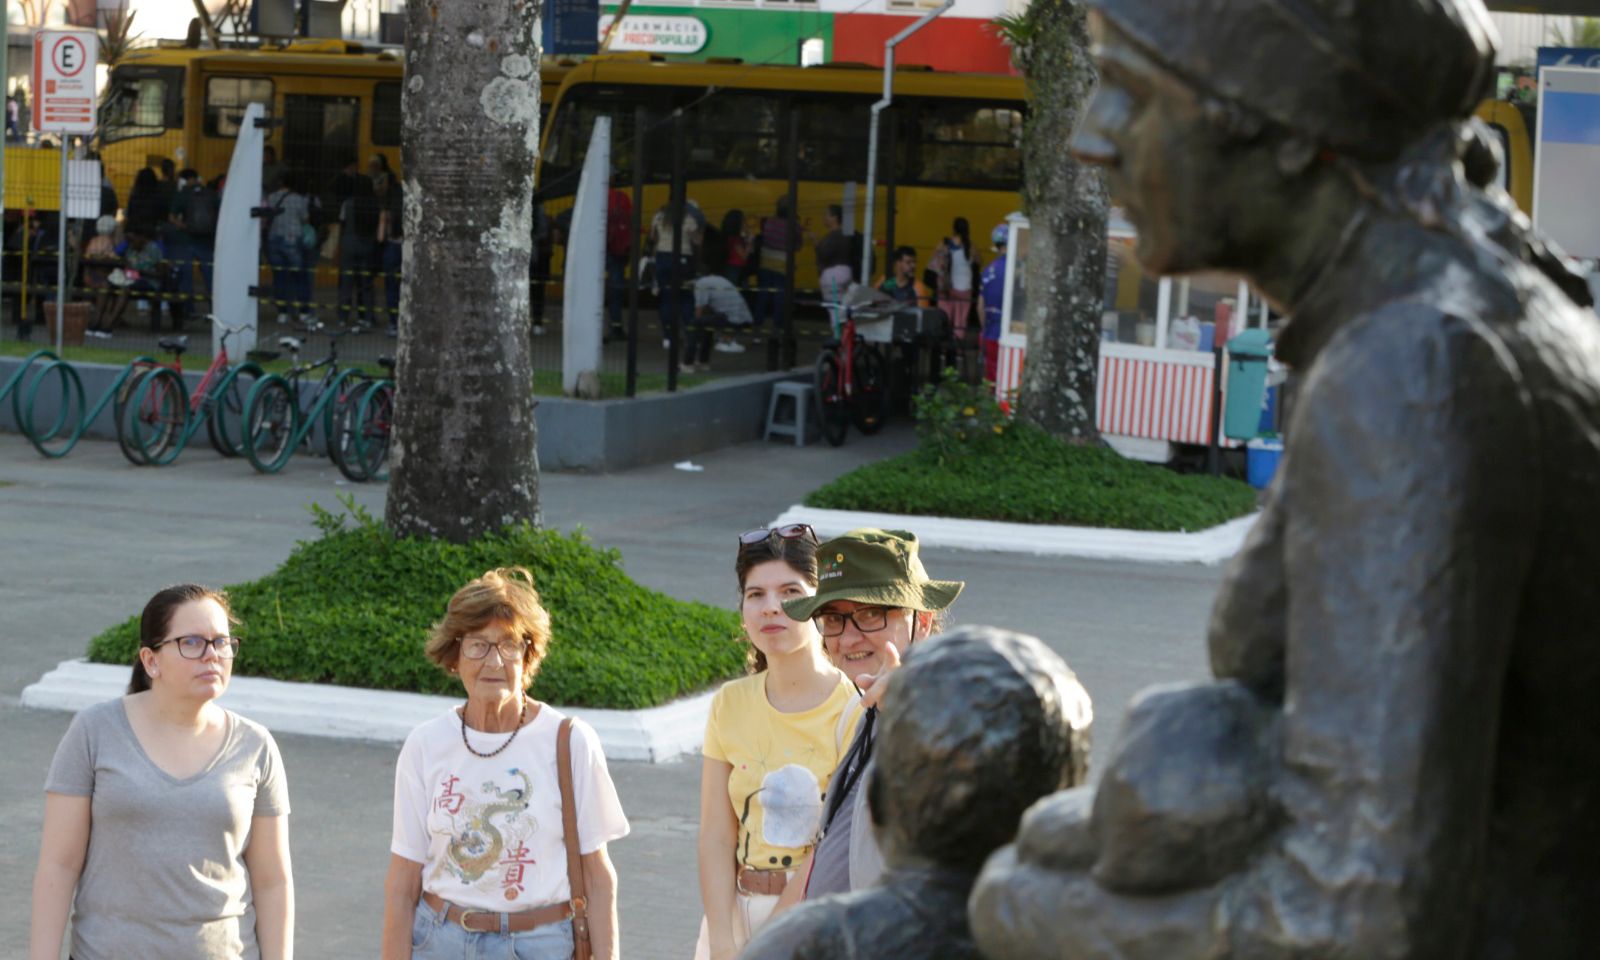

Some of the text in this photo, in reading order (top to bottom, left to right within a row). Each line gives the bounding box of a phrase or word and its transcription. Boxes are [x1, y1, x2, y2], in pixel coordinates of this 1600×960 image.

[623, 21, 699, 32] FARMÁCIA
[62, 45, 75, 68] E
[434, 774, 465, 815] 高
[499, 839, 536, 892] 貴
